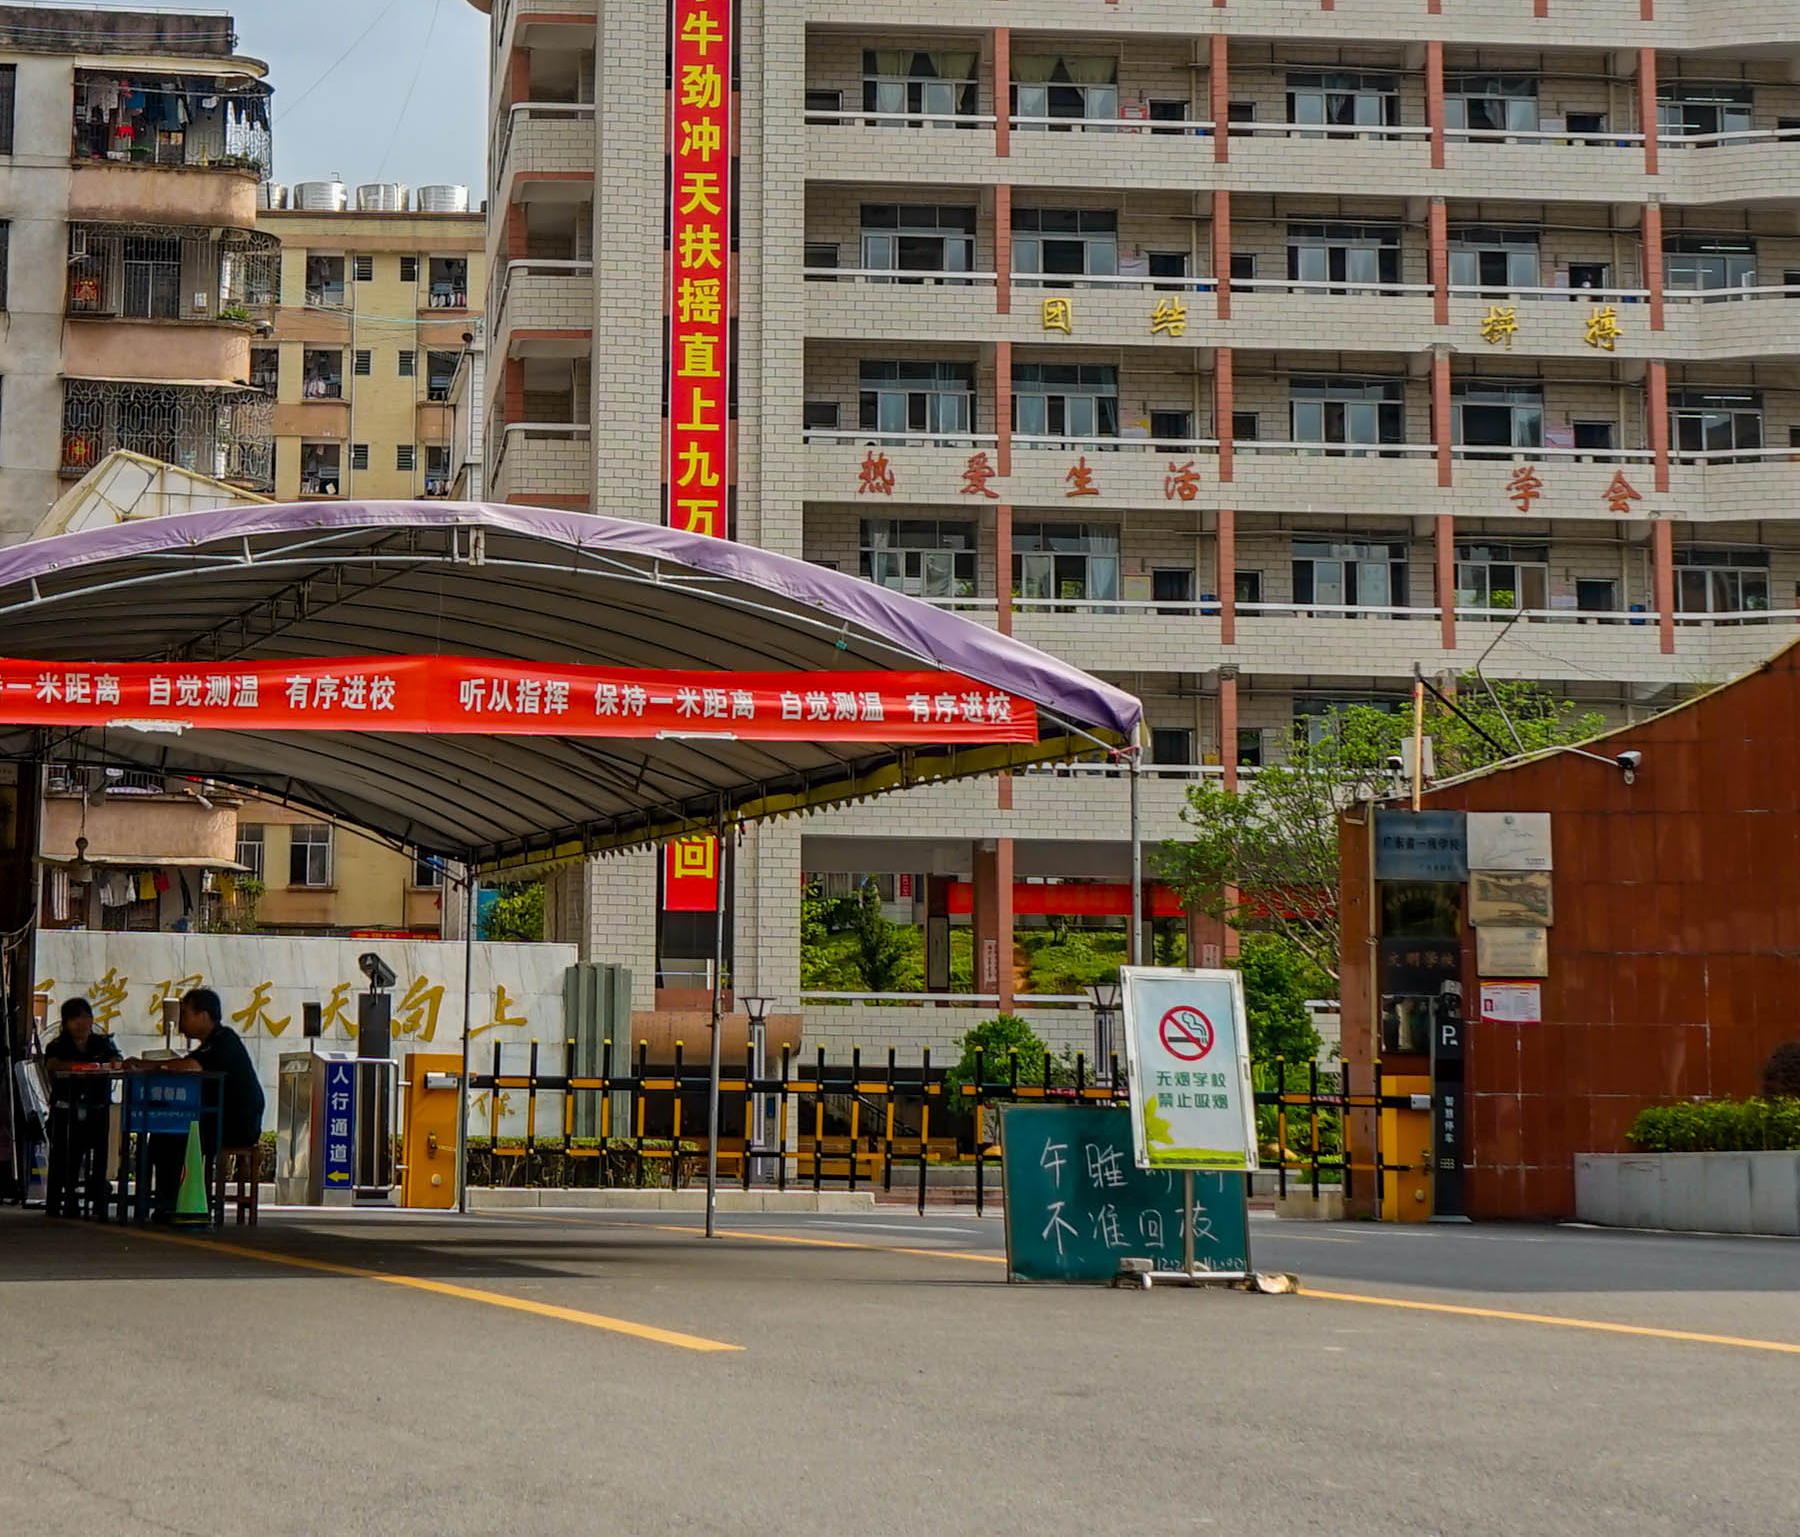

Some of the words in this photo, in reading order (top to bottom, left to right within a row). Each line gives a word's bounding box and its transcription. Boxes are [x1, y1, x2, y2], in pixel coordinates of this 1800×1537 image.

[1041, 295, 1189, 338] 团结
[1480, 305, 1625, 352] 拼搏
[858, 449, 1202, 501] 热爱生活
[1506, 466, 1643, 514] 学会
[148, 673, 259, 709] 自觉测温
[285, 674, 396, 712] 有序进校
[459, 678, 570, 716] 听从指挥
[594, 682, 757, 721] 保持一米距离
[779, 689, 885, 722] 自觉测温
[905, 690, 1013, 724] 有序进校
[1156, 1071, 1226, 1088] 无烟学校
[1158, 1093, 1229, 1110] 禁止吸烟
[331, 1065, 350, 1163] 人行通道
